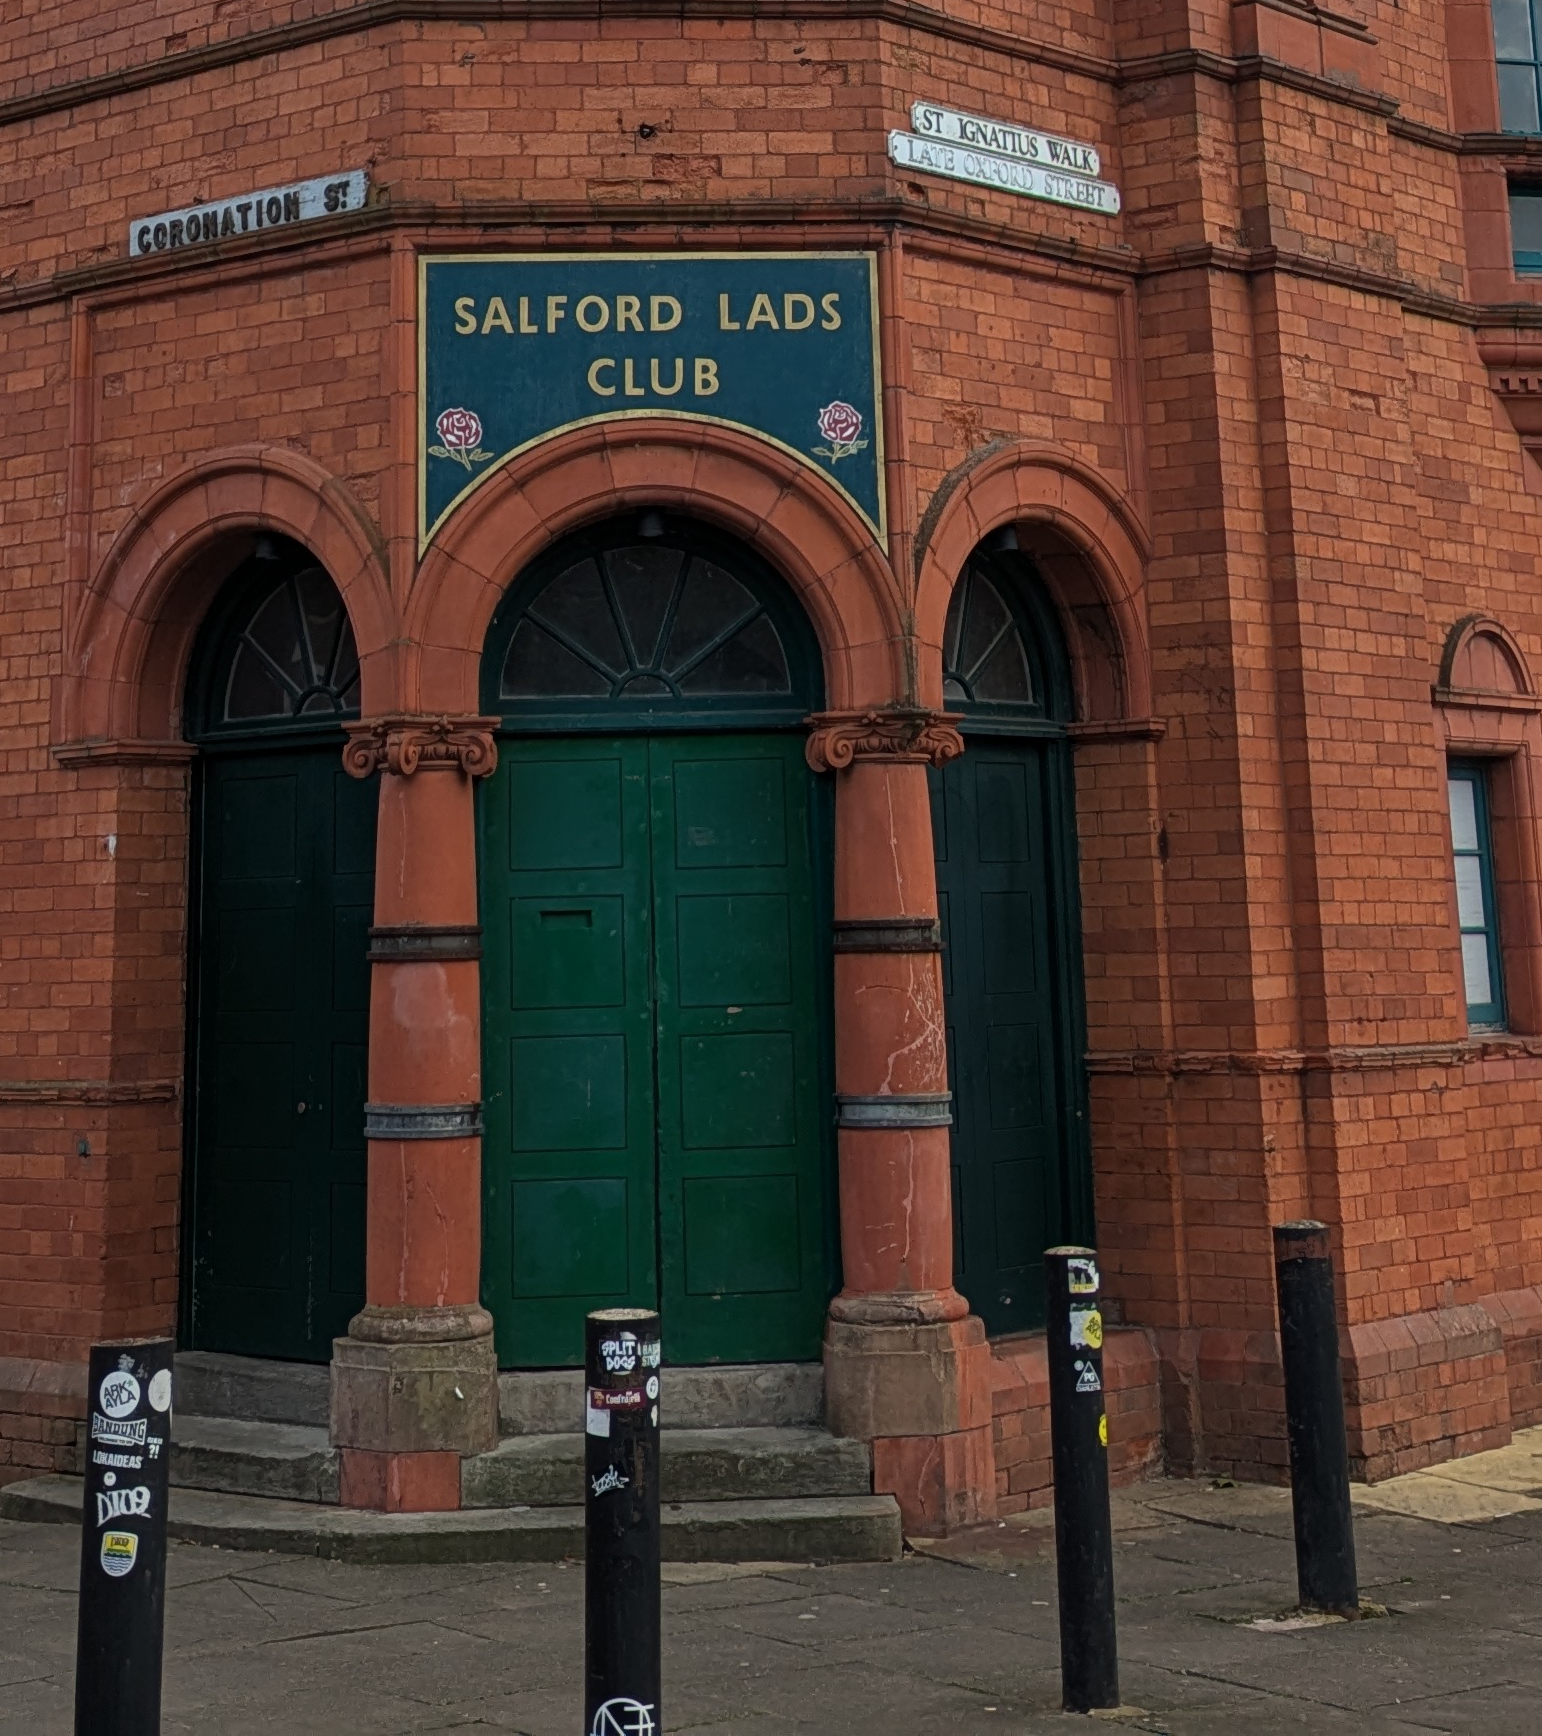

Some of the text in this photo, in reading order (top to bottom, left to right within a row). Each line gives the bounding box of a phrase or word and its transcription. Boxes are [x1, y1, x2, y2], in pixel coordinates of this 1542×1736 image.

[922, 108, 1093, 172] ST IGNATIUS WALK
[907, 139, 1106, 207] LATE OXFORD STREET
[137, 190, 301, 254] CORONATION
[454, 292, 843, 335] SALFORD LADS
[586, 357, 721, 397] CLUB
[601, 1340, 636, 1356] SPLIT
[93, 1413, 146, 1439] BANDUNG
